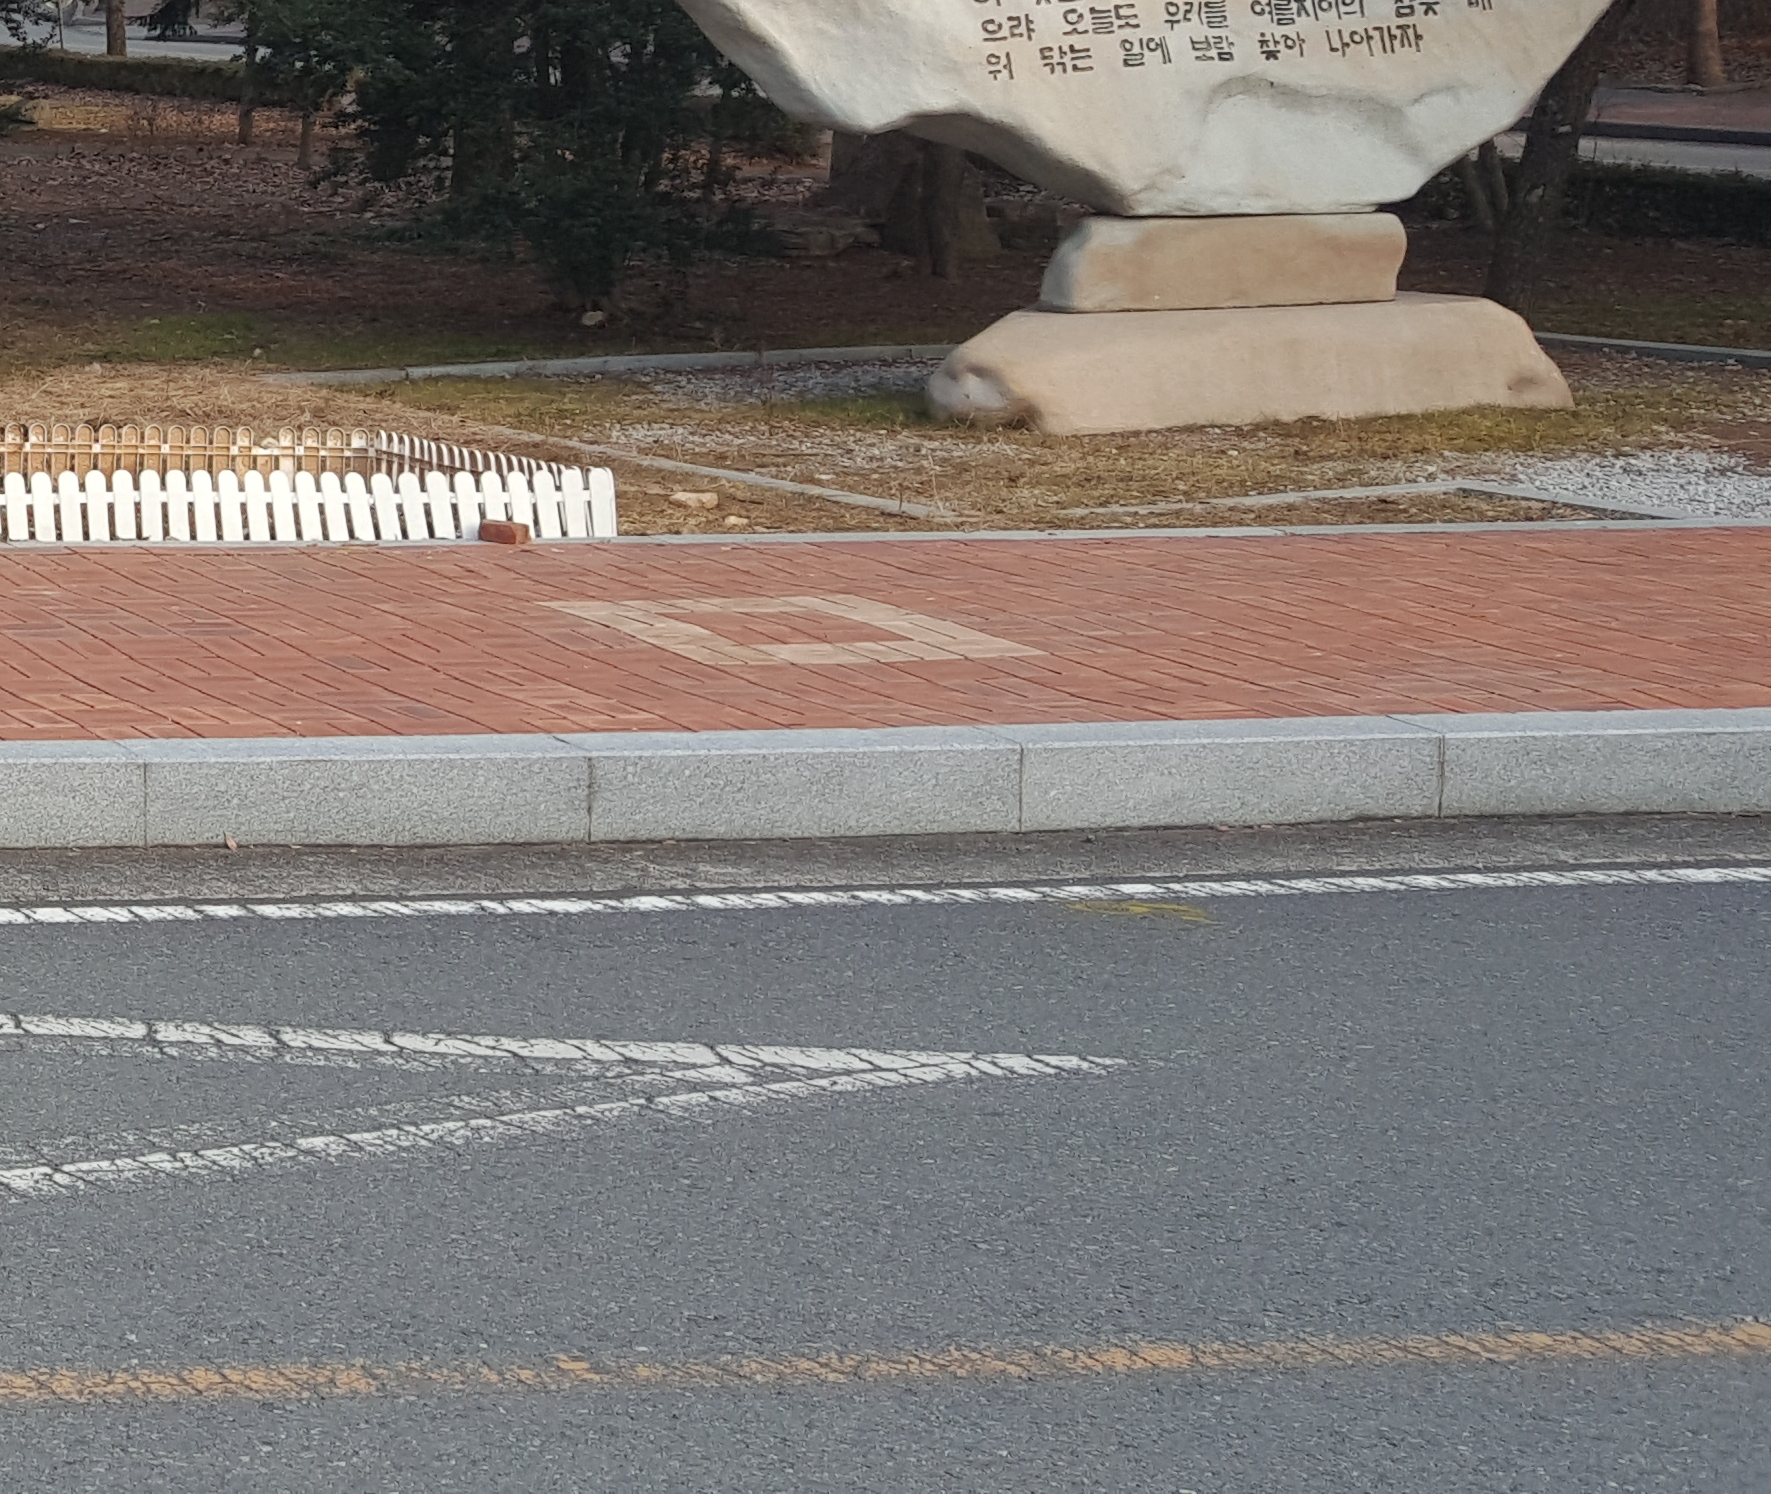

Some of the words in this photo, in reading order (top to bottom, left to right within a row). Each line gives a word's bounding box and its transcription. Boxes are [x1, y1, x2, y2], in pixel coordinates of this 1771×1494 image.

[981, 13, 1036, 42] 으랴
[1062, 3, 1141, 35] 오늘도
[1164, 0, 1229, 31] 우리들
[986, 51, 1014, 81] 워
[1039, 43, 1094, 75] 닦는
[1120, 35, 1172, 68] 일에
[1189, 35, 1235, 62] 보람
[1258, 31, 1306, 61] 찾아
[1325, 23, 1423, 58] 나아가자
